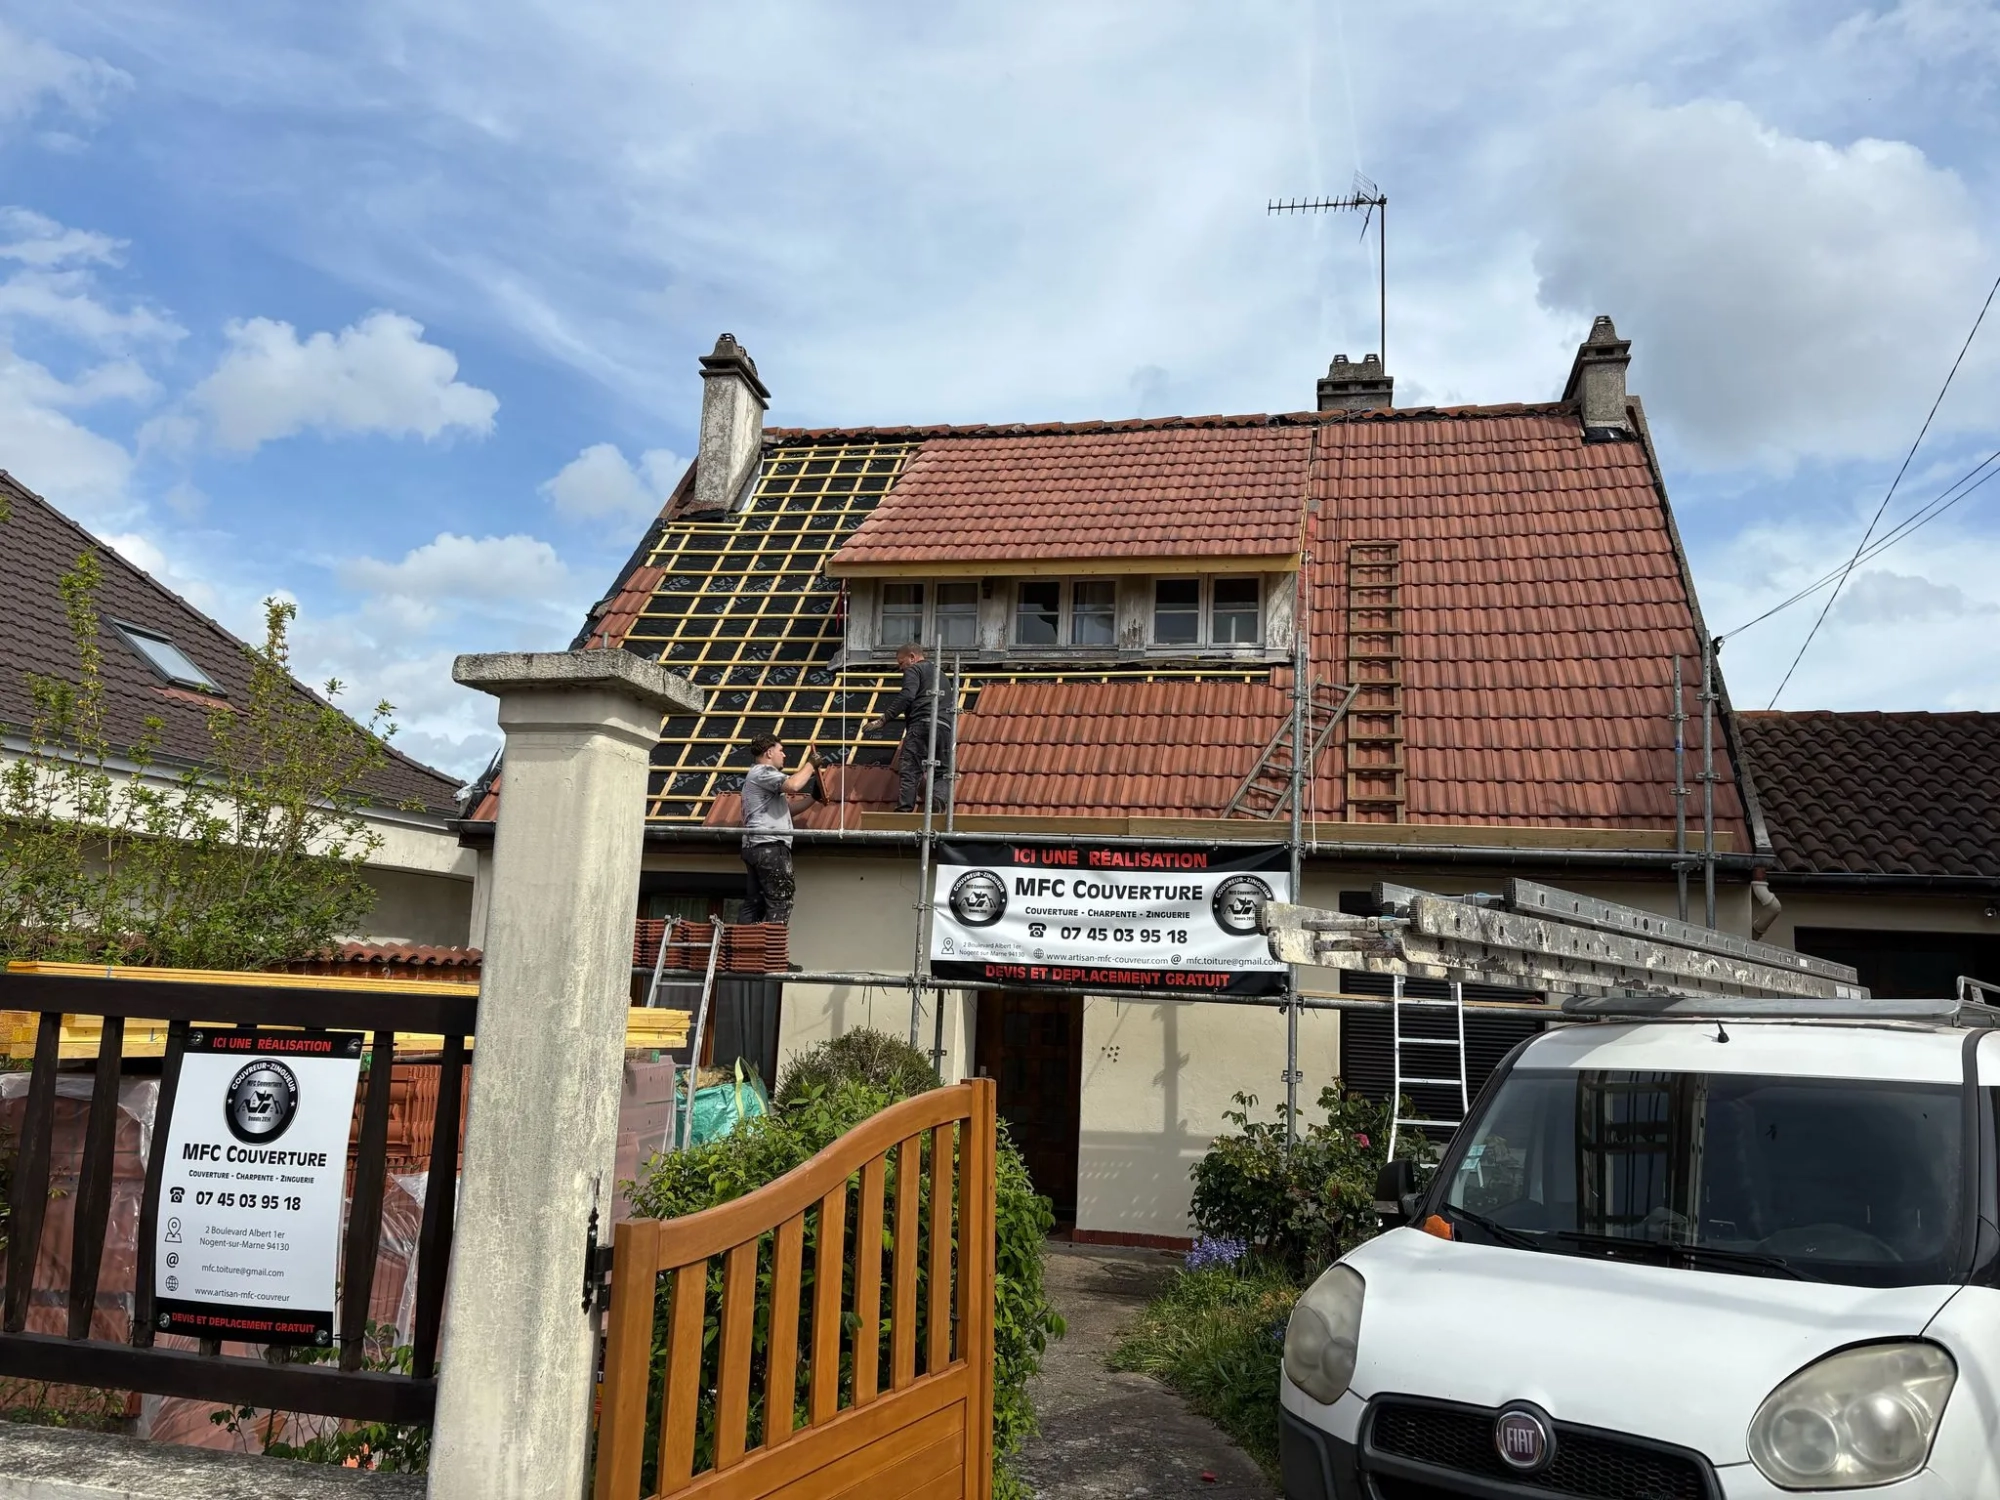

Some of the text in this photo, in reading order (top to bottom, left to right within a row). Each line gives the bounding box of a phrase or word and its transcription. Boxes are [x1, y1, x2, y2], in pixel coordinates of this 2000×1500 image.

[1013, 849, 1207, 868] ICI UNE RÉALISATION
[1015, 877, 1203, 901] MFC COUVERTURE
[1060, 927, 1188, 944] 07 45 03 95 18
[1046, 953, 1168, 965] www.artisan-mfc-couvreur.com
[1186, 956, 1282, 968] mfc.toiture@gmail.com
[985, 964, 1230, 987] DEVIS ET DEPLACEMENT GRATUIT
[213, 1037, 331, 1052] ICI UNE RÉALISATION
[231, 1062, 296, 1093] COUVREUR-ZINGUEUR
[182, 1143, 327, 1167] MFC COUVERTURE
[196, 1191, 301, 1211] 07 45 03 95 18
[205, 1225, 285, 1239] 2 Boulevard Albert 1er
[199, 1237, 289, 1251] Nogent-sur-Marne 94130
[202, 1264, 284, 1278] mfc.toiture@gmail.com
[194, 1287, 290, 1302] www.artisan-mfc-couvreur
[171, 1312, 315, 1334] DEVIS ET DEPLACEMENT GRATUIT
[1506, 1427, 1535, 1454] FIAT
